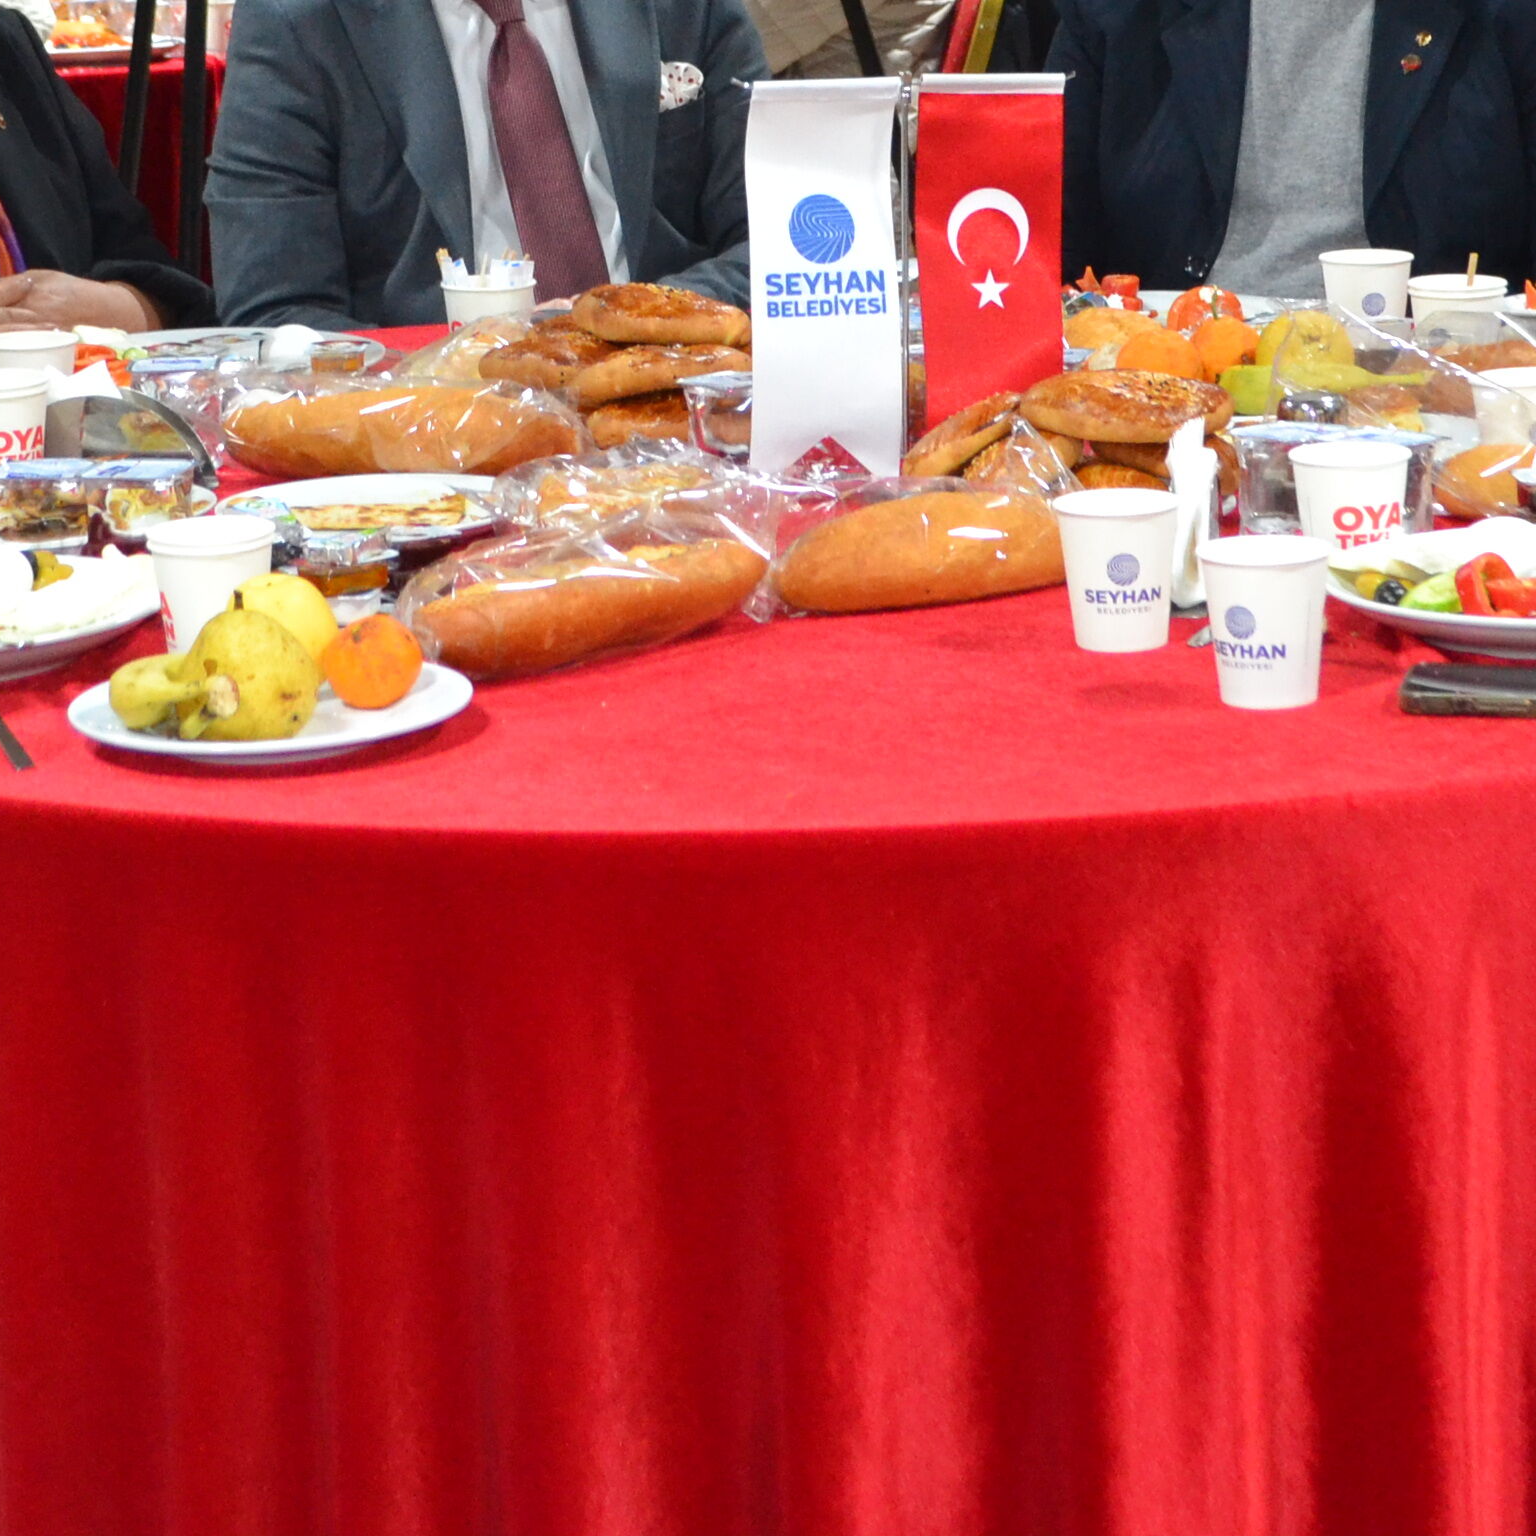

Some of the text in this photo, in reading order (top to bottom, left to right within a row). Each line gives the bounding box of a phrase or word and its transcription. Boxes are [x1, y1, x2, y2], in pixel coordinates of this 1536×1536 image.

[765, 270, 885, 296] SEYHAN
[767, 293, 887, 318] BELEDİYESİ
[1332, 501, 1401, 532] OYA
[1335, 531, 1390, 550] TEK
[1084, 586, 1162, 604] SEYHAN
[1214, 639, 1287, 660] SEYHAN
